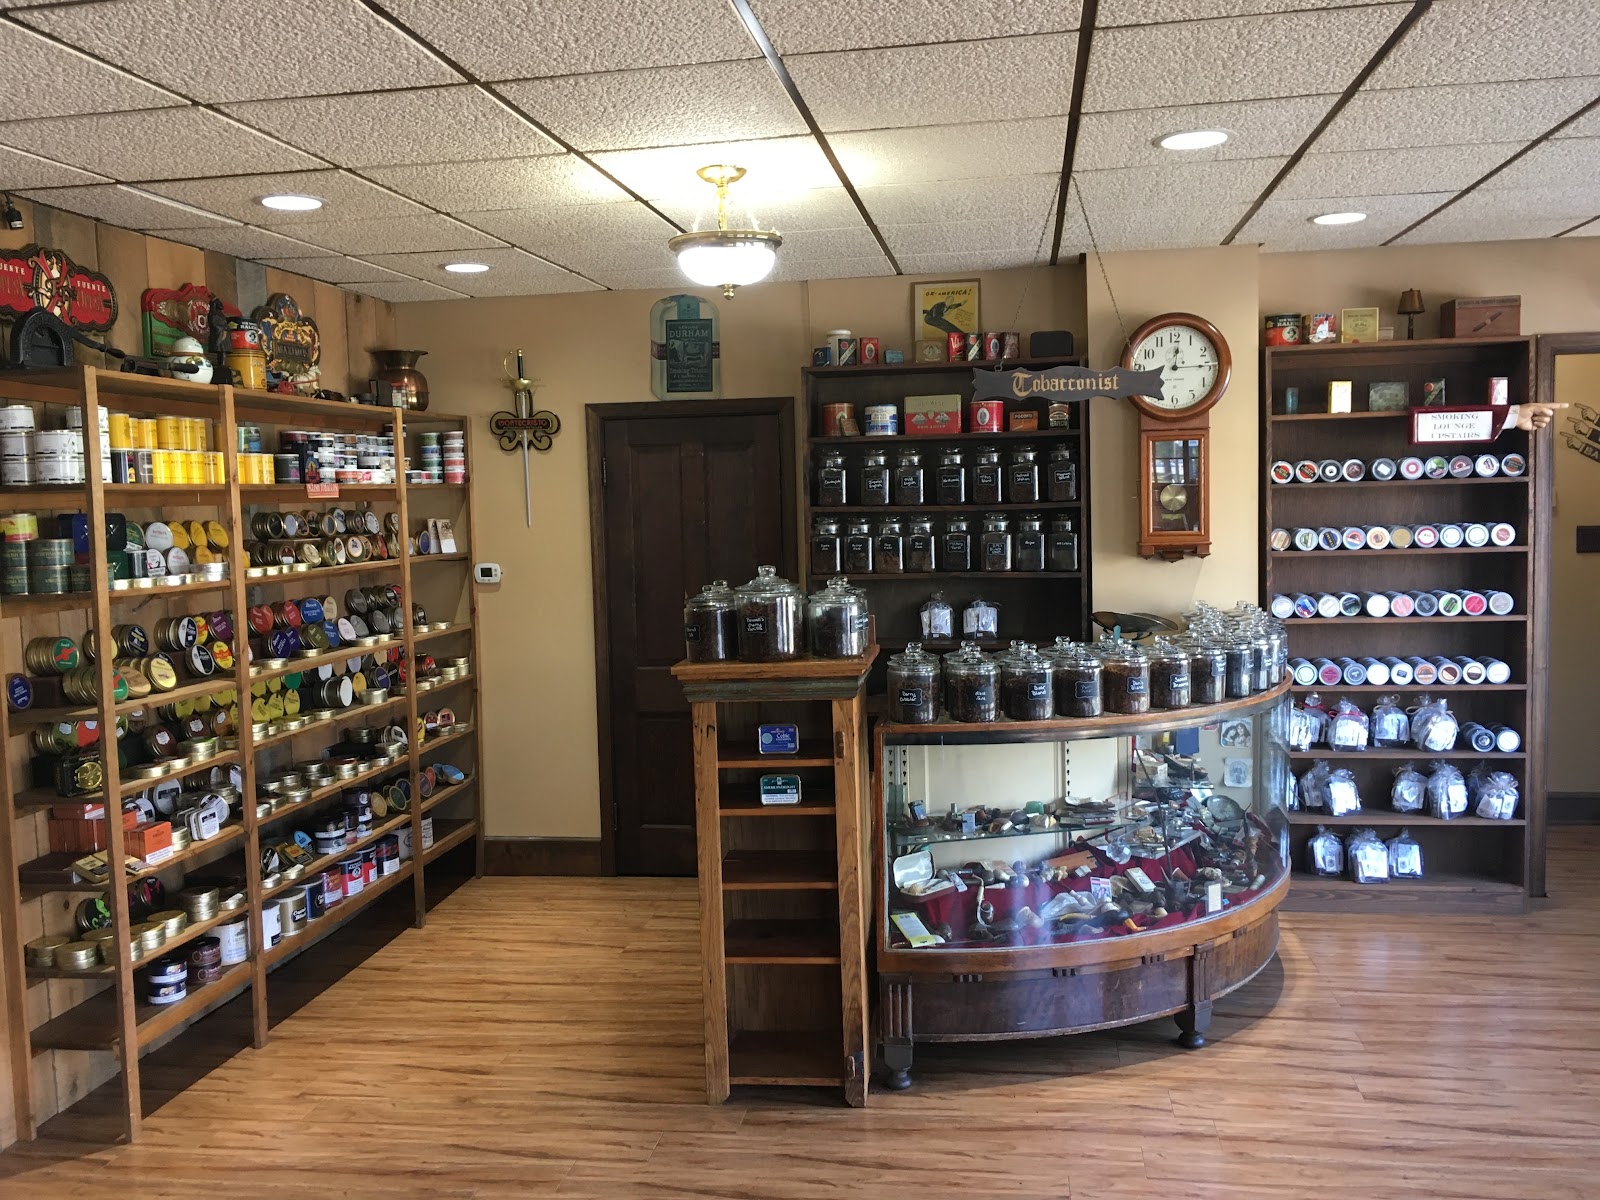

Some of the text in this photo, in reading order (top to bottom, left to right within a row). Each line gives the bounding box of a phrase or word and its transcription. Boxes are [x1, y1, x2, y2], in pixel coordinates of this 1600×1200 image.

[0, 263, 26, 275] UENTE
[77, 281, 106, 292] FUENTE
[669, 330, 708, 338] DURHAM
[1169, 331, 1181, 343] 12
[1156, 336, 1163, 347] 11
[1189, 335, 1192, 346] 1
[1144, 349, 1155, 360] 10
[1199, 346, 1207, 357] 2
[1011, 372, 1119, 397] Tobacconist
[1171, 394, 1178, 405] 6
[1188, 389, 1195, 400] 5
[1433, 422, 1476, 430] LOUNGE
[1583, 446, 1599, 459] BA
